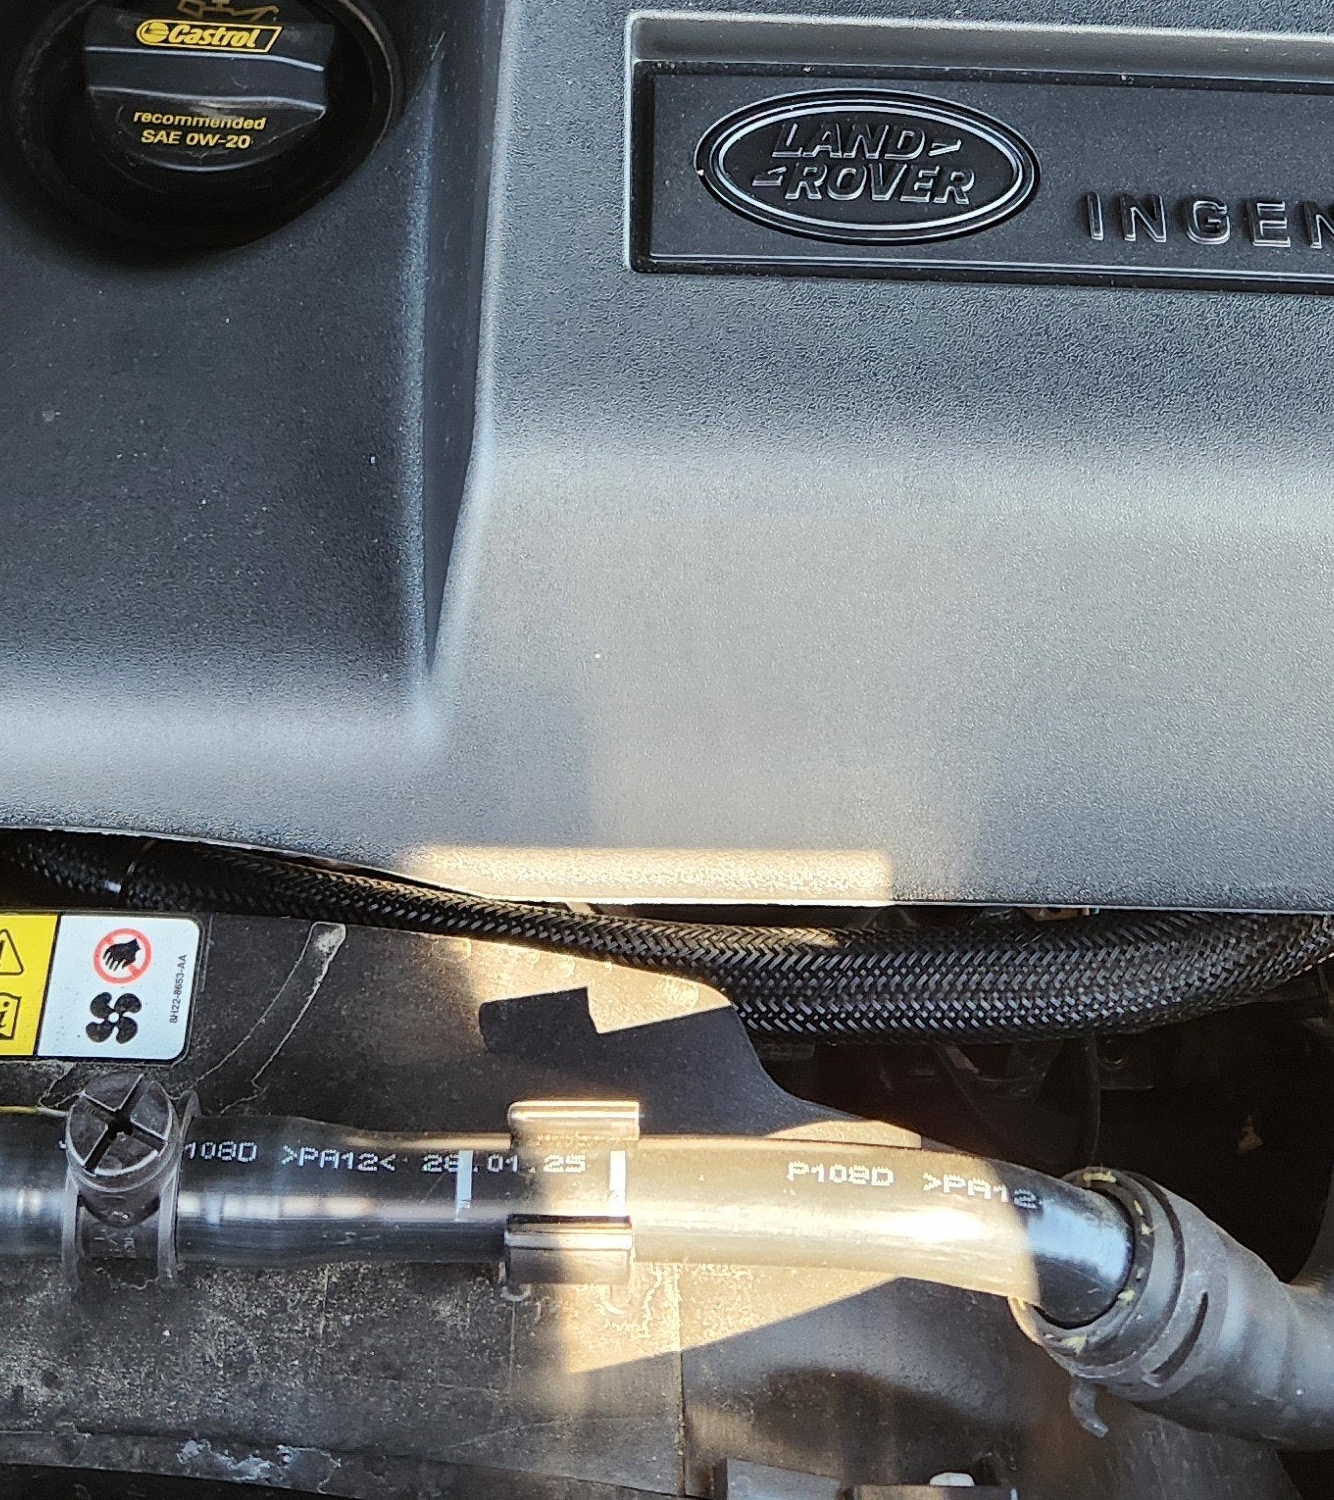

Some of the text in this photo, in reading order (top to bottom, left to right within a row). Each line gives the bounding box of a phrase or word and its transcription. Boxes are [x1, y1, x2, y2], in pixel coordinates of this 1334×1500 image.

[169, 24, 260, 48] Castrol
[133, 111, 266, 131] recommended
[141, 129, 251, 150] SAE 0W-20
[771, 119, 925, 160] LAND
[783, 160, 976, 208] ROVER
[184, 1140, 257, 1163] 108D
[923, 1171, 1042, 1210] >PA12
